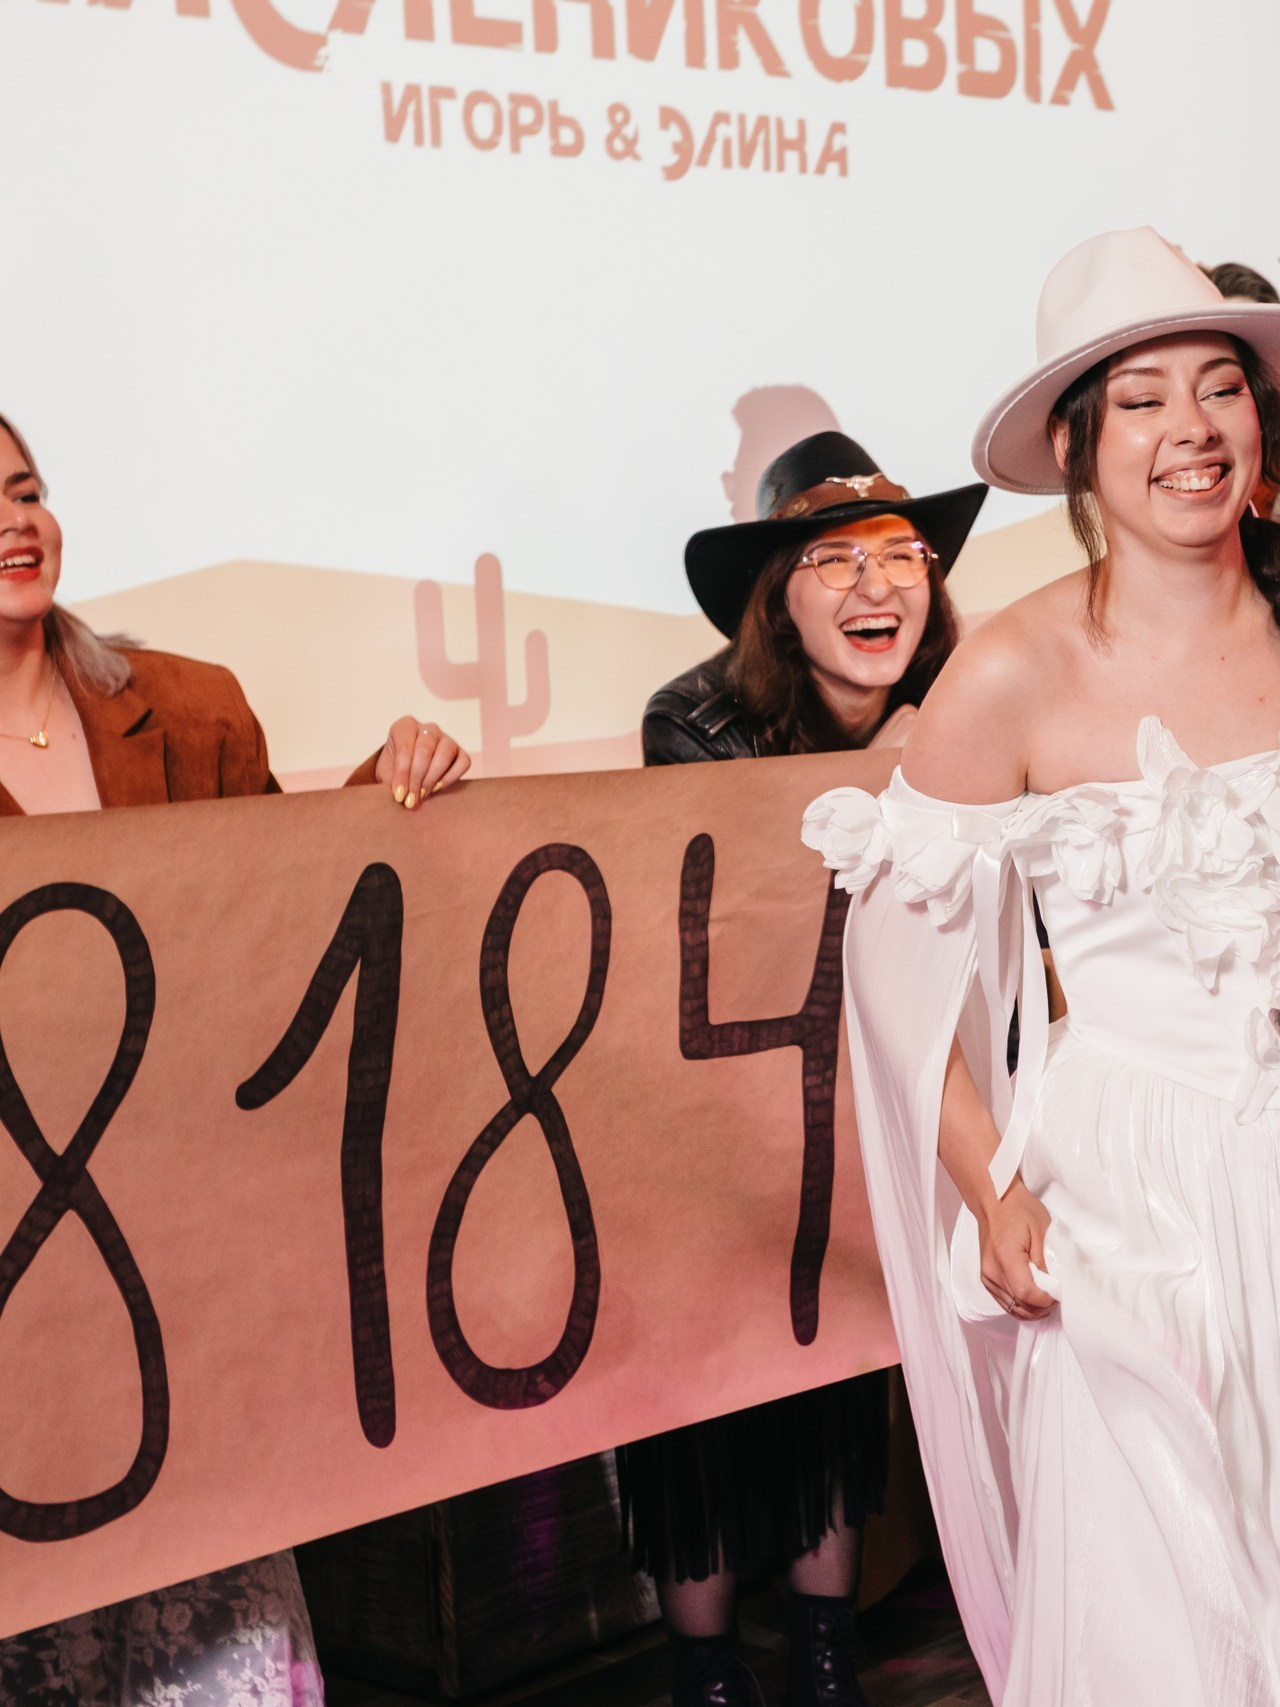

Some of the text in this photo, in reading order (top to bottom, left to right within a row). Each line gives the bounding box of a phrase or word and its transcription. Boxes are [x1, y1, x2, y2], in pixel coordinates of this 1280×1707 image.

[380, 81, 849, 181] ИГОРЬ & ЭЛИНА
[0, 832, 846, 1543] 8184
